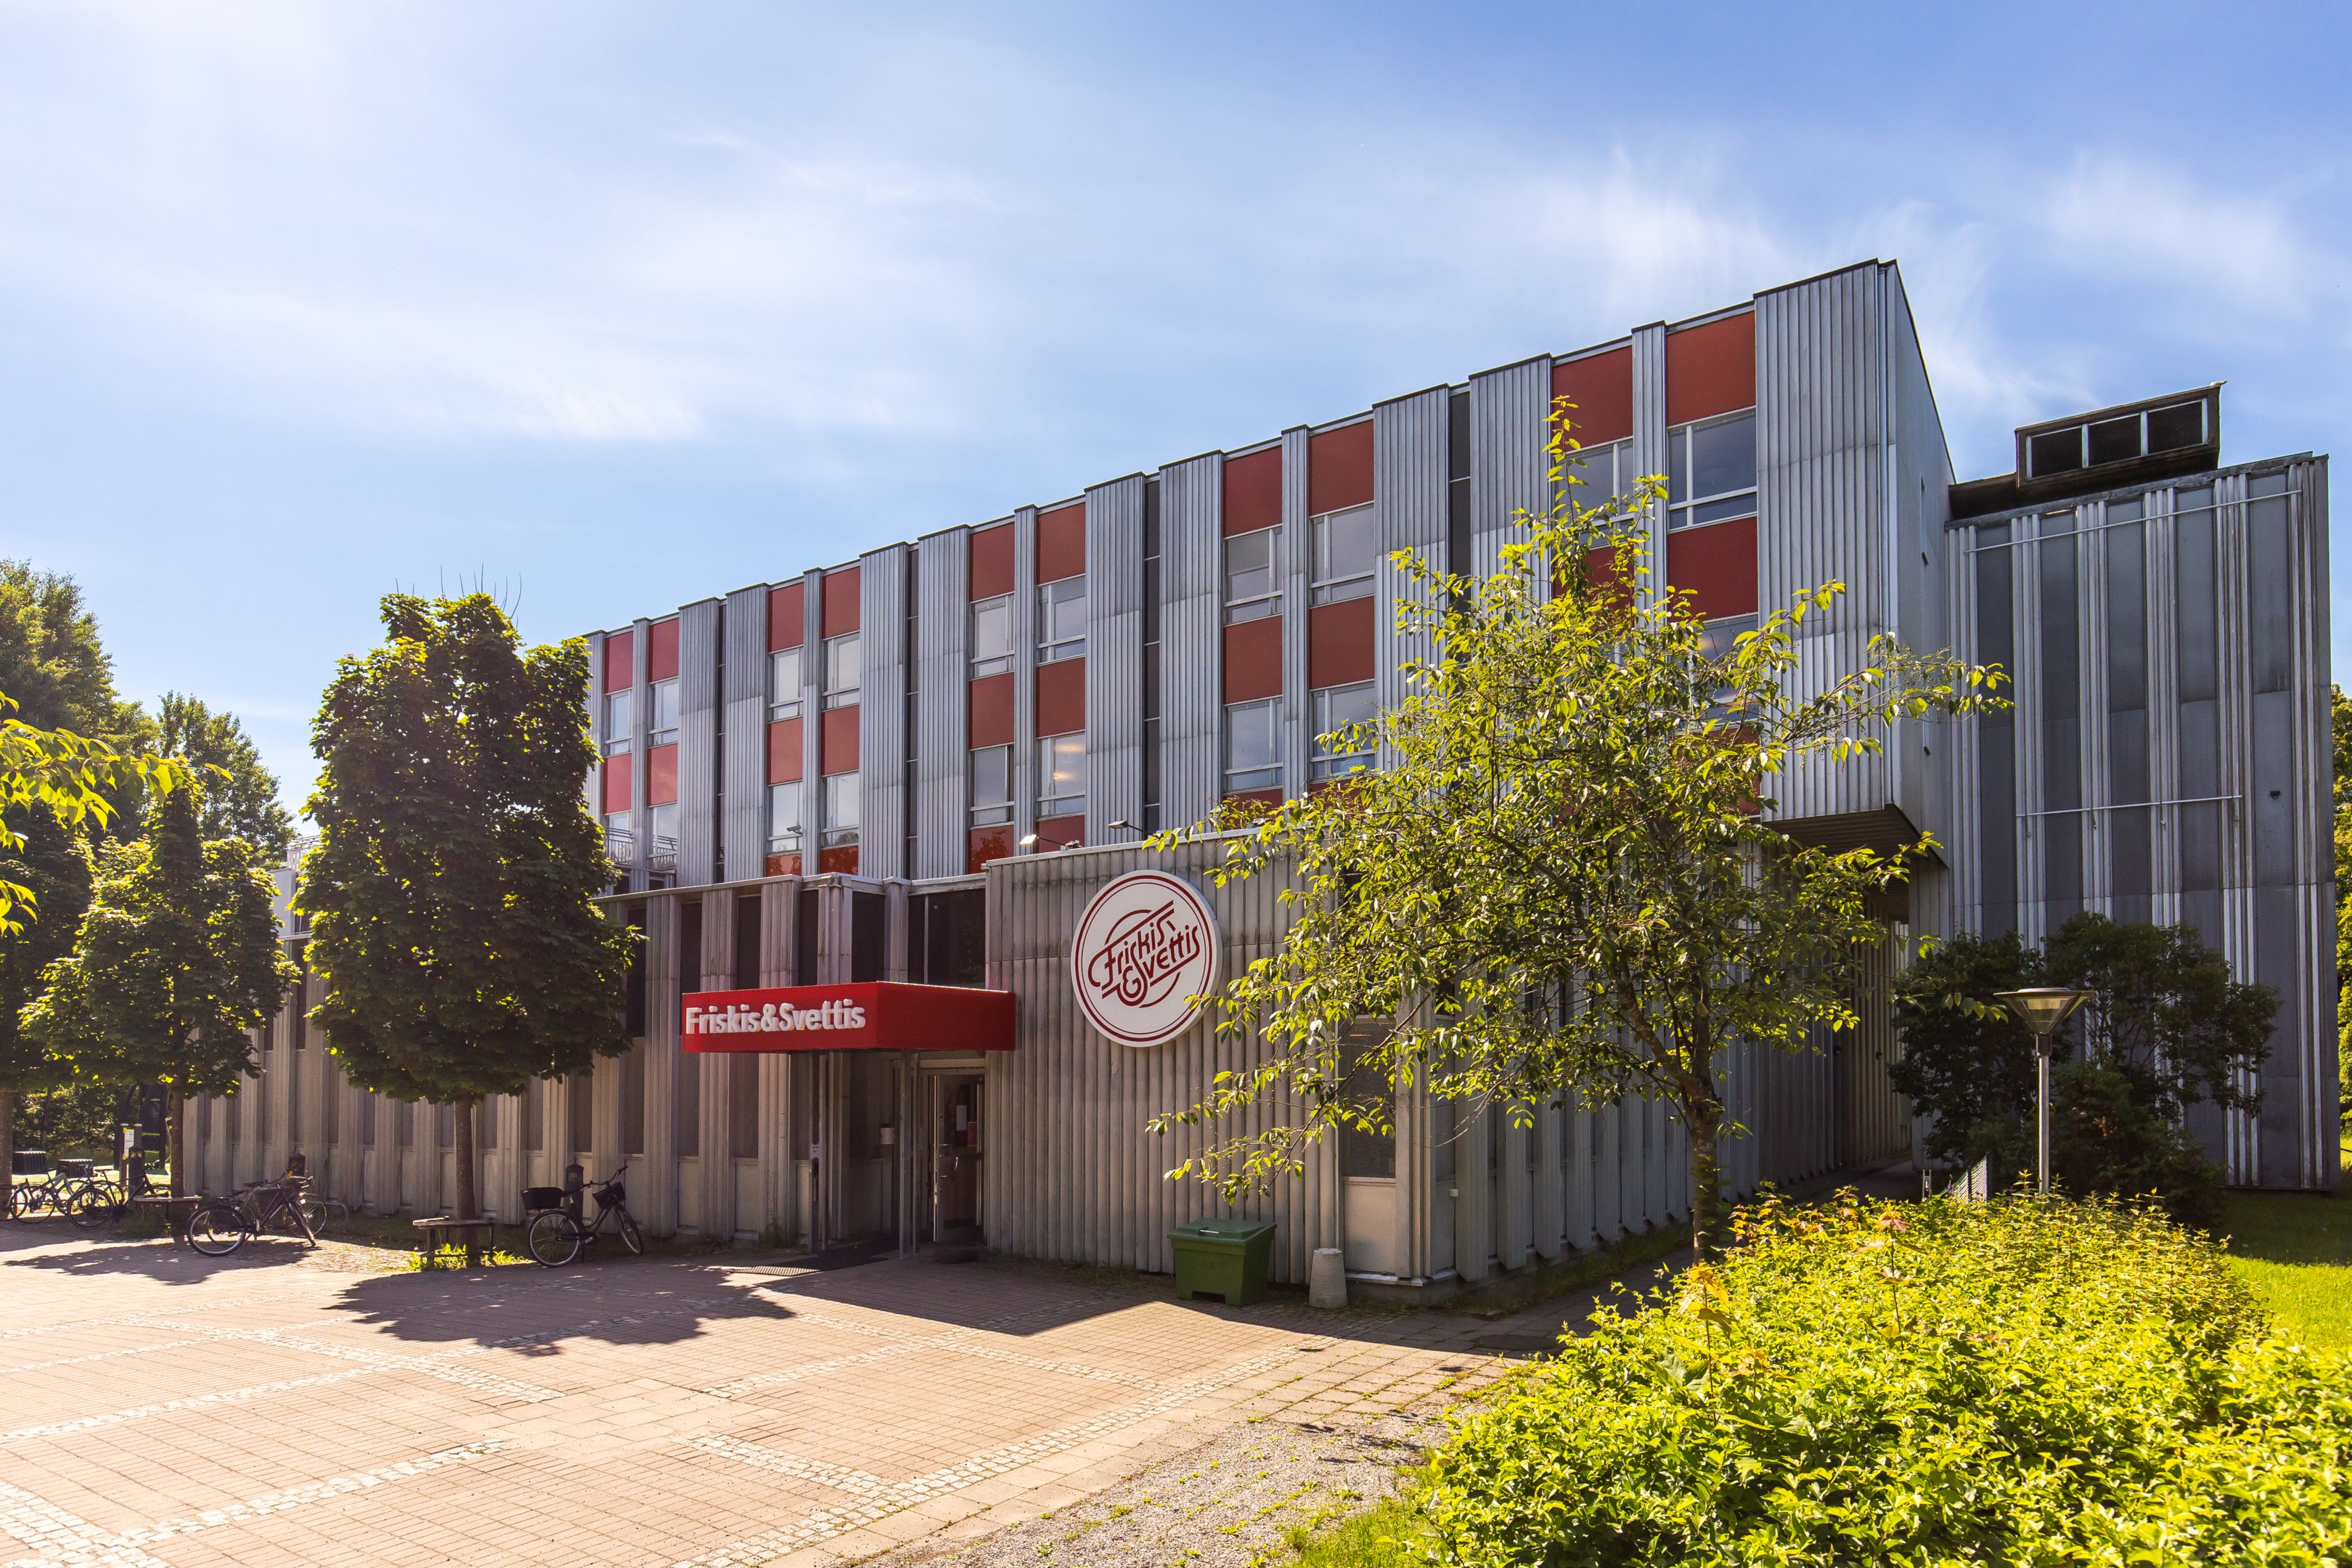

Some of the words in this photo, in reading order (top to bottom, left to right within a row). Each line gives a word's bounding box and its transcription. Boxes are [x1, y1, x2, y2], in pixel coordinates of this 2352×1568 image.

[1088, 899, 1175, 991] Friskis
[1102, 925, 1200, 1006] Svettis
[686, 999, 866, 1034] Friskis&Svettis
